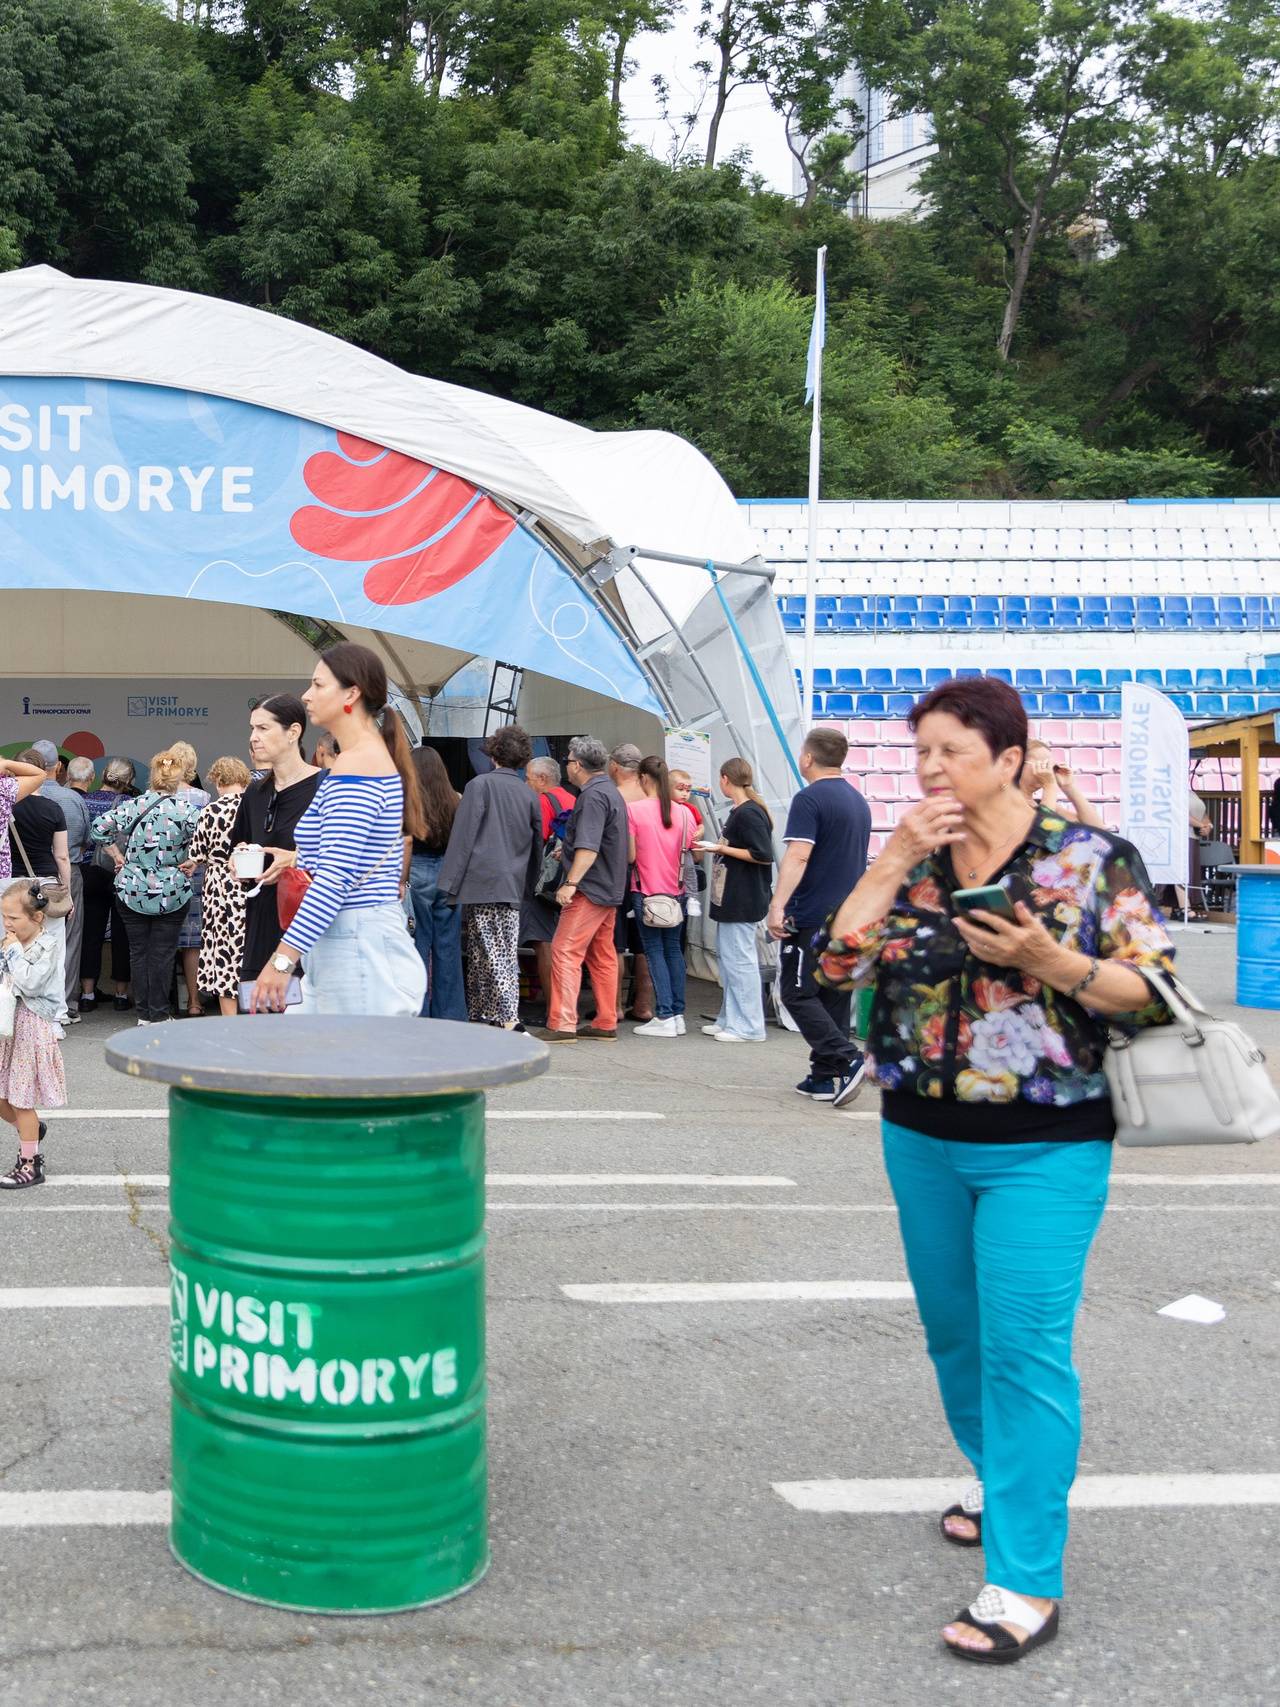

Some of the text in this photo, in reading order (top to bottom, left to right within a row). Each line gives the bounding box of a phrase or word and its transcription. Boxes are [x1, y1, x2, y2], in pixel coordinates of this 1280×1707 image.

[148, 696, 179, 706] VISIT
[148, 707, 209, 717] PRIMORYE
[194, 1282, 323, 1349] VISIT
[194, 1333, 458, 1406] PRIMORYE
